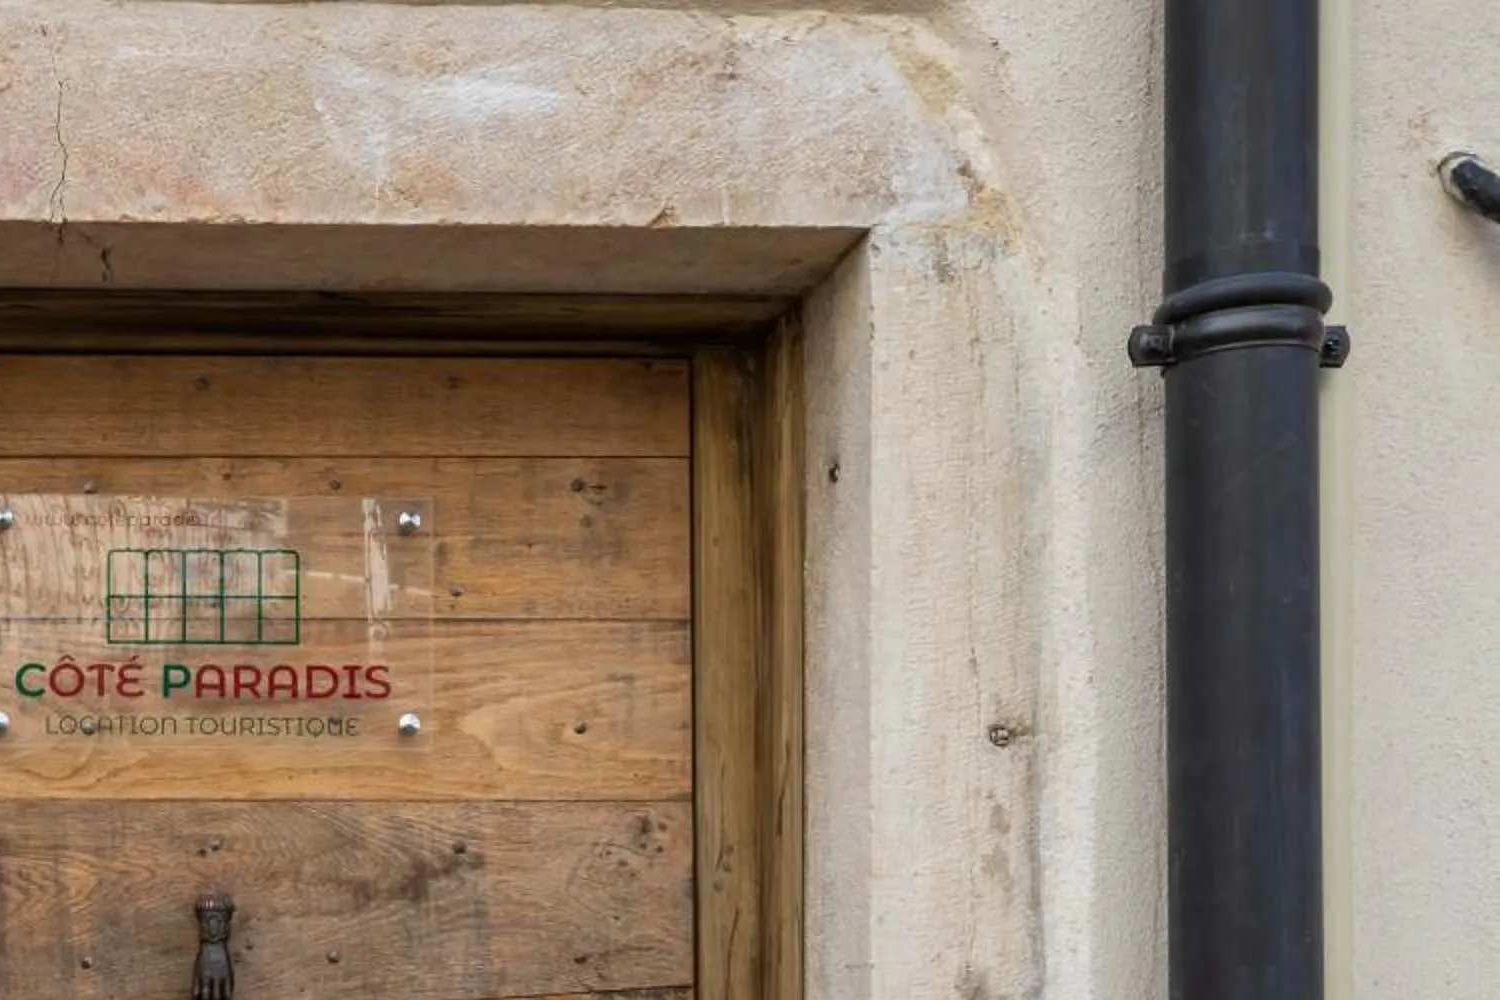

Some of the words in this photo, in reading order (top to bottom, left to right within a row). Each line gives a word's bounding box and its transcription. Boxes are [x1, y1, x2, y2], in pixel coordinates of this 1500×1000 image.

[15, 655, 145, 698] CÔTÉ
[163, 664, 391, 699] PARADIS
[45, 714, 178, 736] LOCATION
[186, 715, 361, 738] TOURISTIQUE
